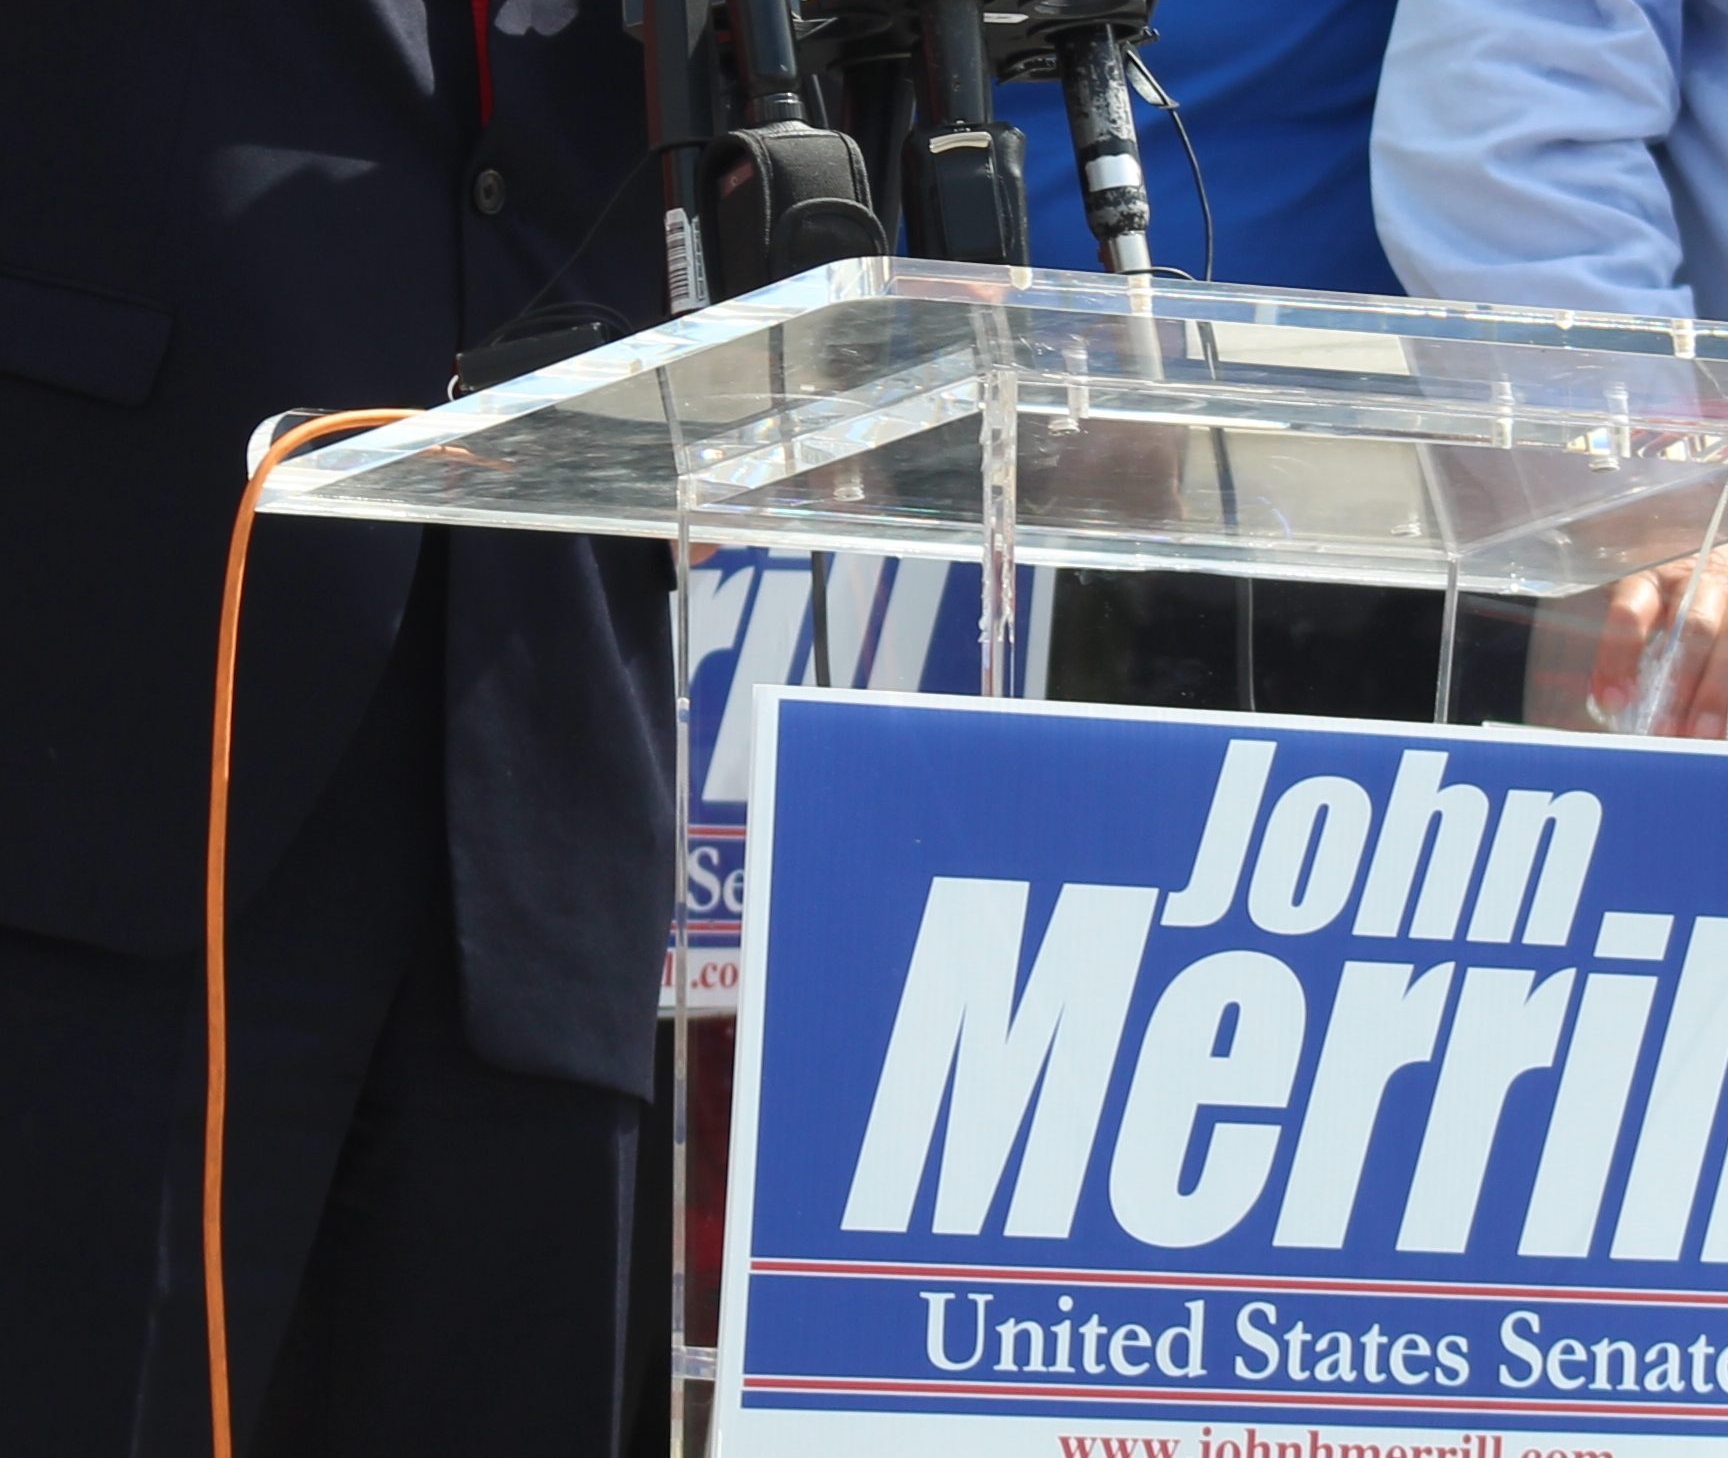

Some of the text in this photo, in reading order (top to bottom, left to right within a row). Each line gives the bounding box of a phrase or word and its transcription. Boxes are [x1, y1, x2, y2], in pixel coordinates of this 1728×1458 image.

[1160, 739, 1603, 946] John
[920, 1291, 1207, 1380] United
[1233, 1301, 1471, 1387] States
